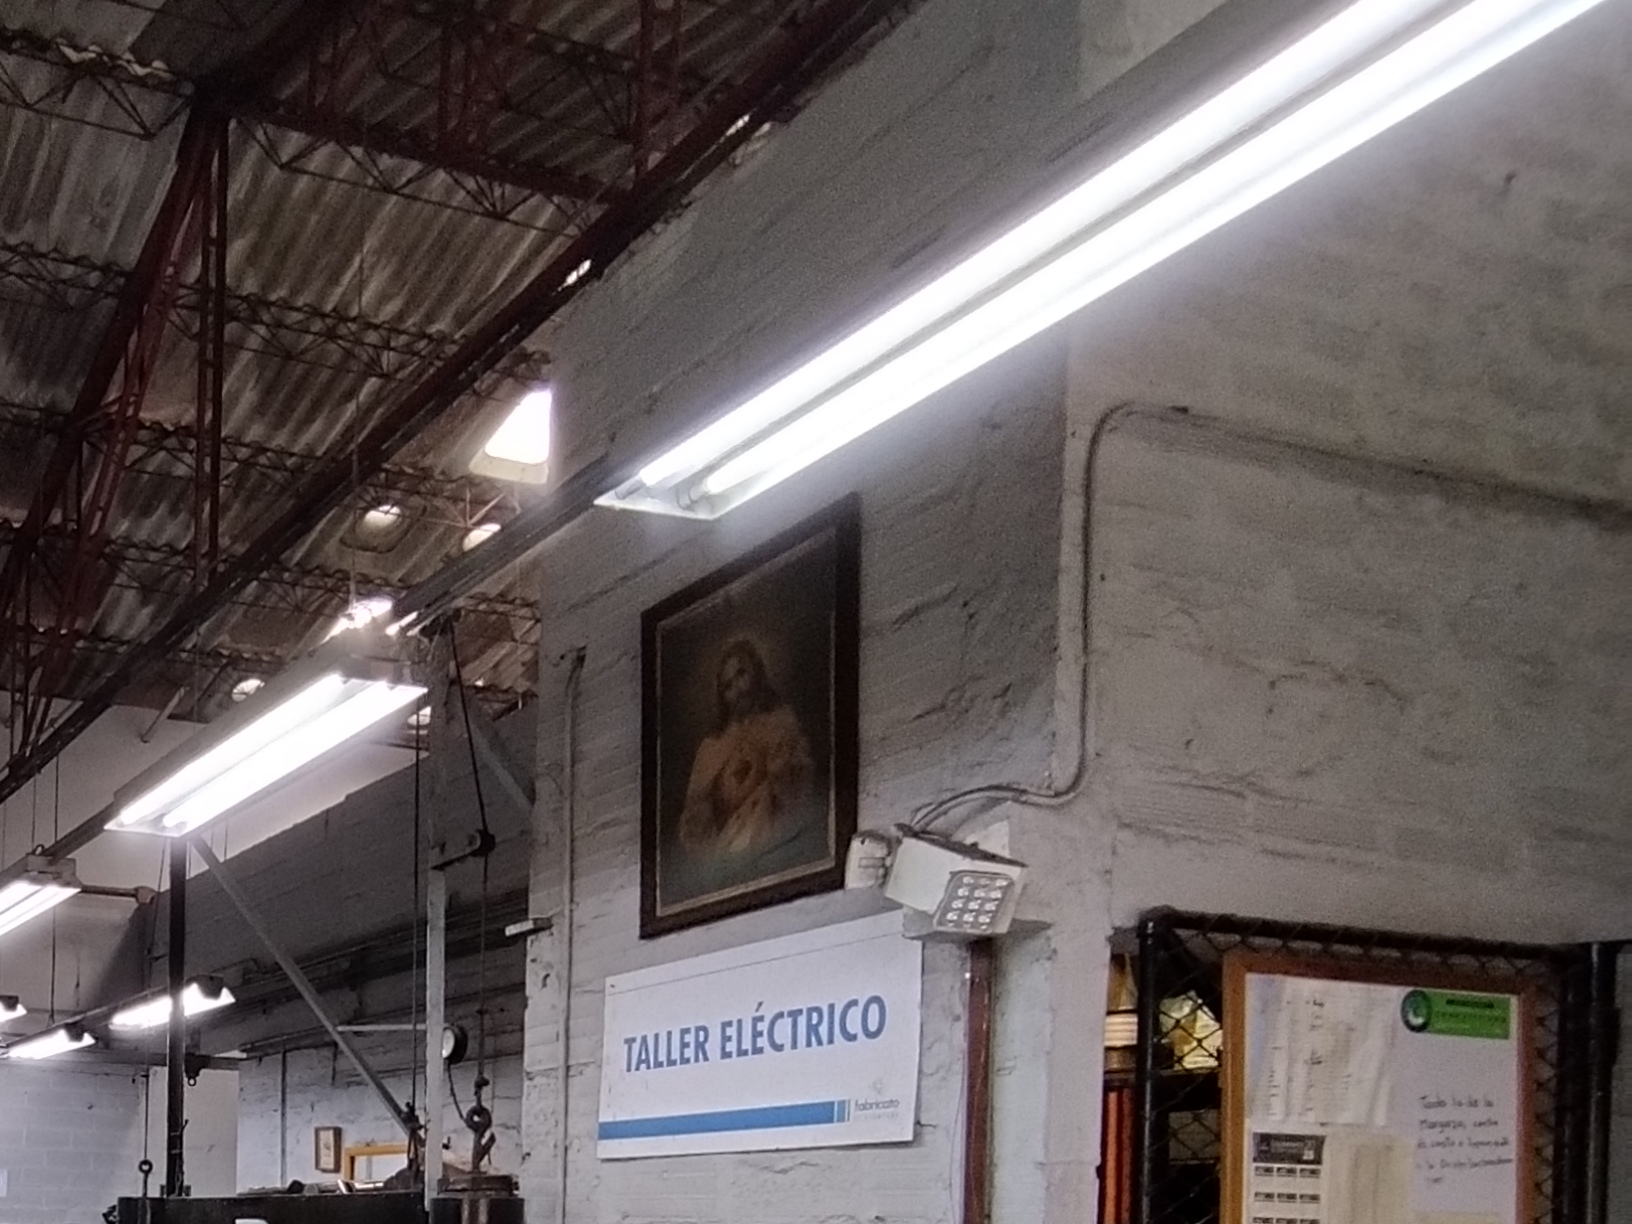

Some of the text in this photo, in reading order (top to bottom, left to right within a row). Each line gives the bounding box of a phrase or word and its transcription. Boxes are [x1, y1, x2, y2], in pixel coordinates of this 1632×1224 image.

[623, 994, 887, 1073] TALLER ELÉCTRICO
[854, 1098, 900, 1112] fabricato
